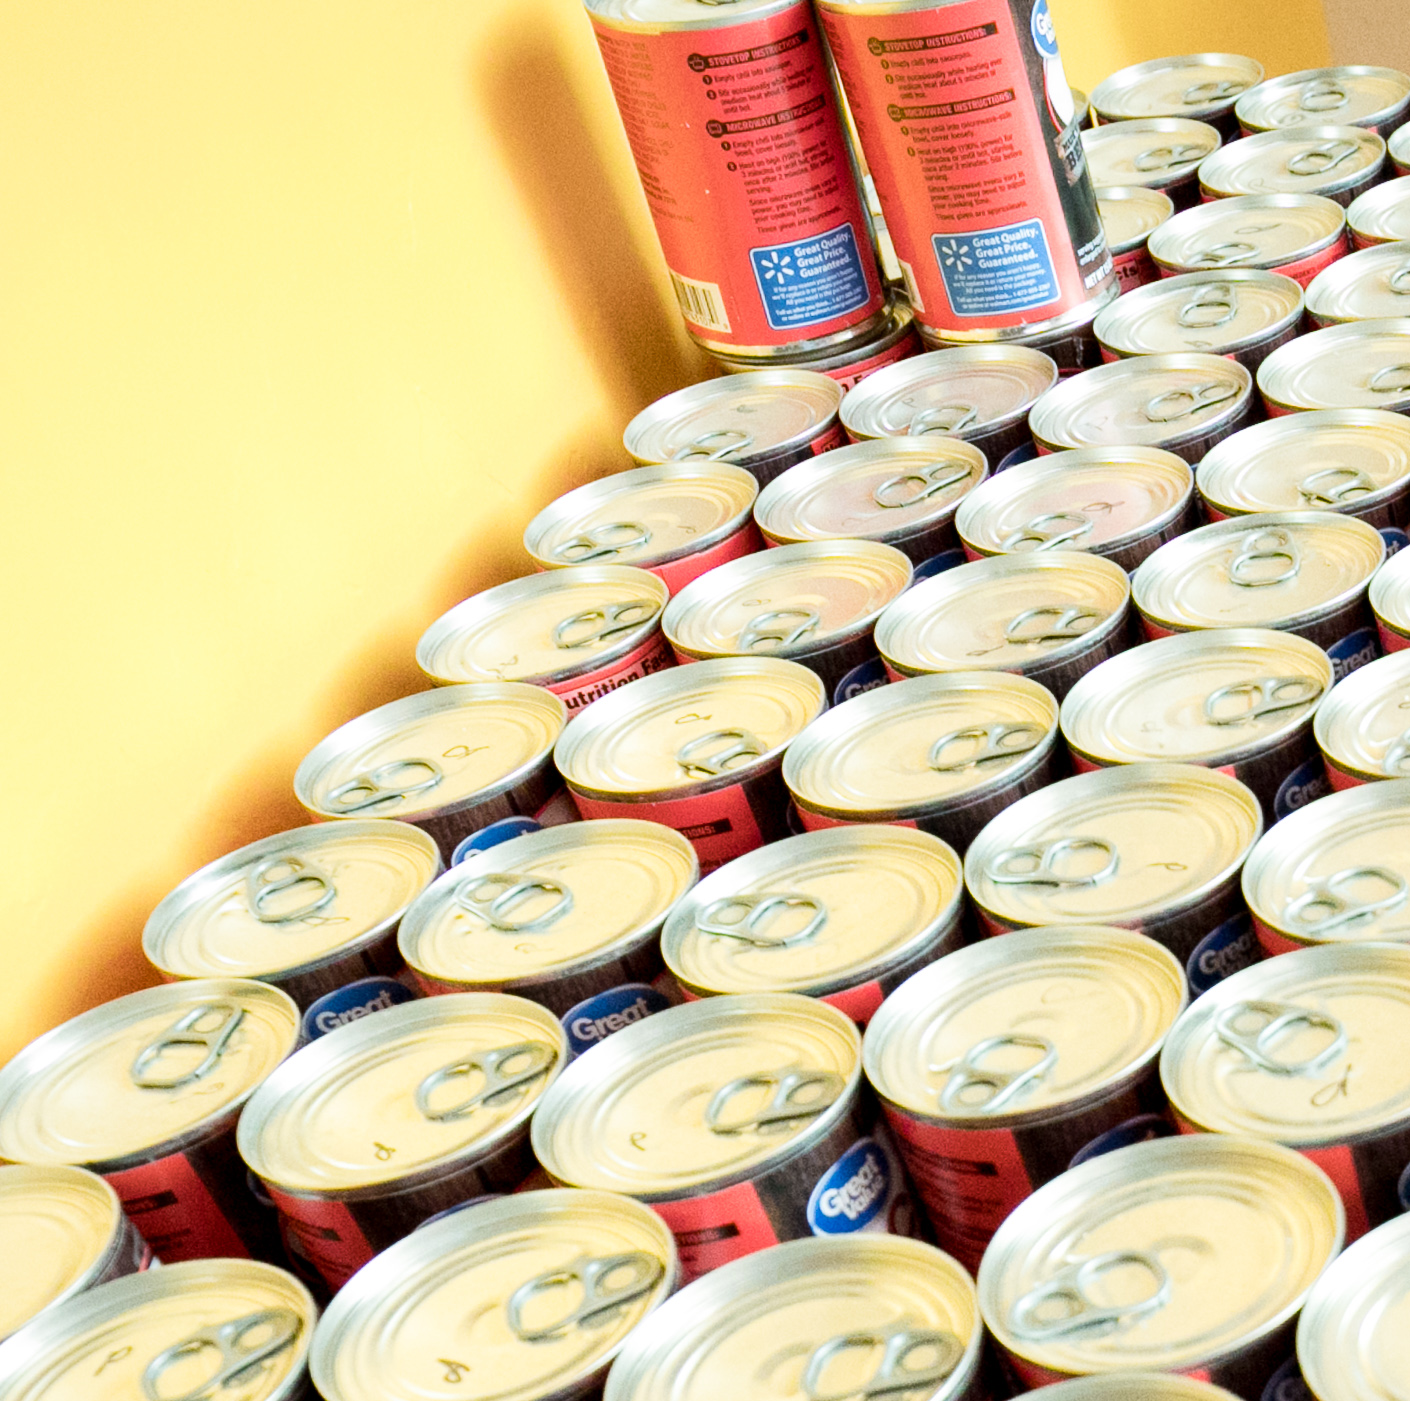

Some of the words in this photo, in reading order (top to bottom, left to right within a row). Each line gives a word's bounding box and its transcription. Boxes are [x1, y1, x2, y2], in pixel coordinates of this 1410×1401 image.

[886, 41, 924, 52] STOVETOP
[926, 27, 987, 48] INSTRUCTIONS:
[708, 52, 750, 66] STOVETOP
[904, 104, 951, 117] MICROWAVE
[953, 91, 1012, 112] INSTRUCTIONS:
[726, 114, 776, 132] MICROWAVE
[794, 242, 821, 257] Great
[821, 232, 851, 249] Quality.
[972, 237, 1001, 248] Great
[1001, 227, 1038, 243] Quality.
[797, 253, 823, 268] Great
[976, 247, 1004, 259] Great
[1005, 242, 1032, 254] Price.
[978, 251, 1038, 269] Guaranteed.
[800, 254, 852, 278] Guaranteed.
[571, 997, 652, 1042] Great
[819, 1153, 880, 1217] Great
